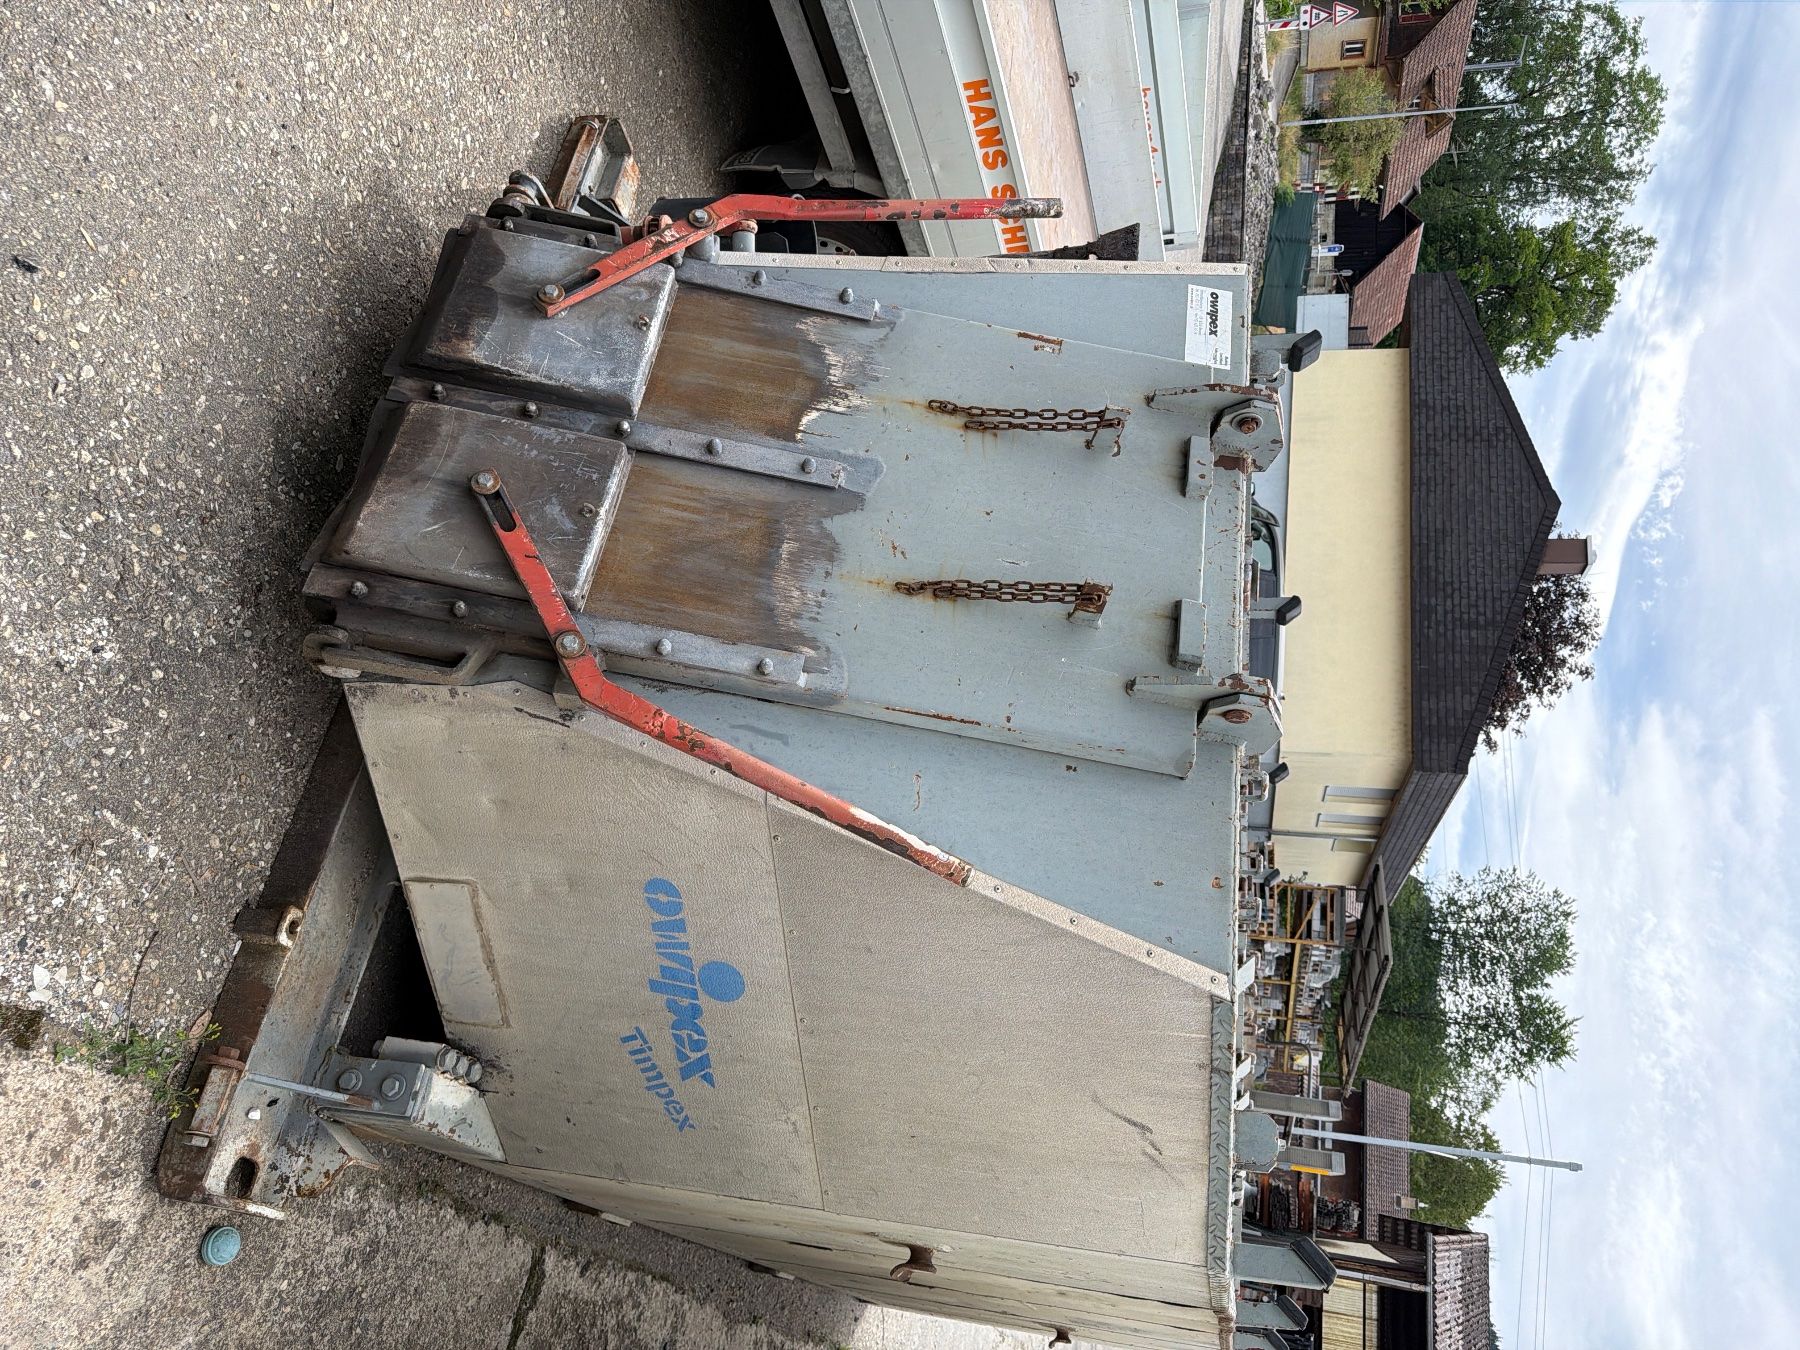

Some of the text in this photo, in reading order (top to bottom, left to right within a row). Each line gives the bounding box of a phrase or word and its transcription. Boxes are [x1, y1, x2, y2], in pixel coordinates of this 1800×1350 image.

[963, 79, 1008, 170] HANS
[1206, 292, 1219, 337] owipex
[643, 877, 747, 1088] owipex
[619, 1026, 697, 1133] Timpex
